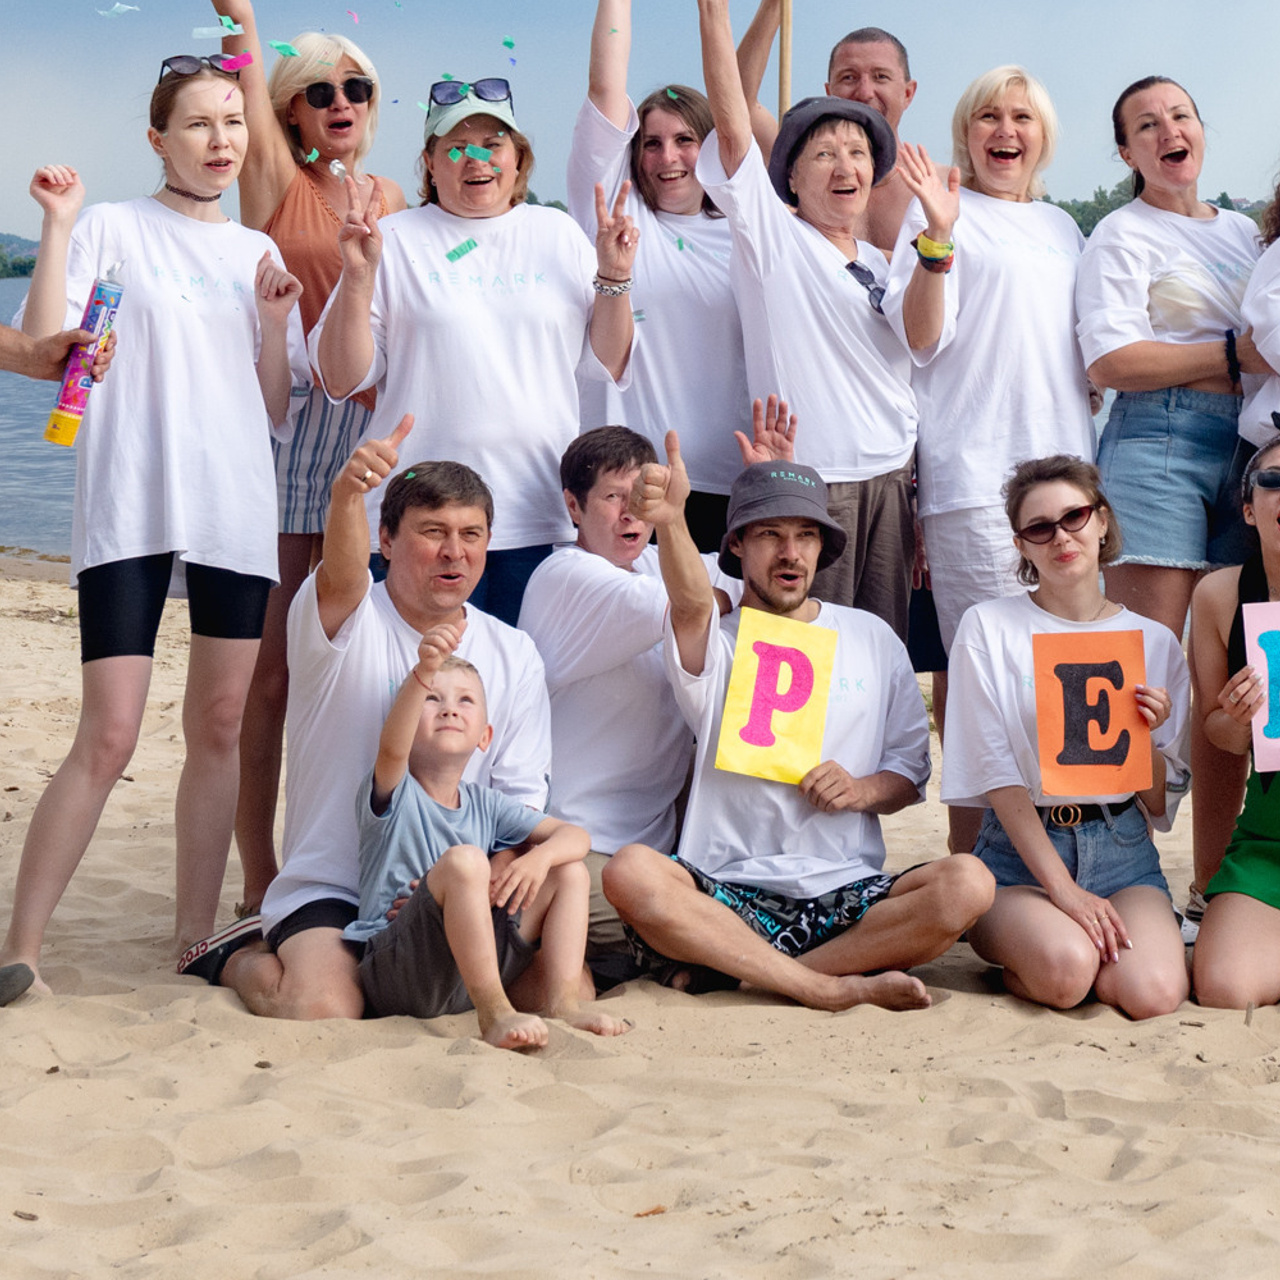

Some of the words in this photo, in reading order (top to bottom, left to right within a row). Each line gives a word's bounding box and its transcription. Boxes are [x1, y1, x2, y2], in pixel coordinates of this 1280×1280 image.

[153, 266, 255, 296] REMAR
[428, 271, 547, 288] REMARK
[770, 471, 817, 488] REMARK
